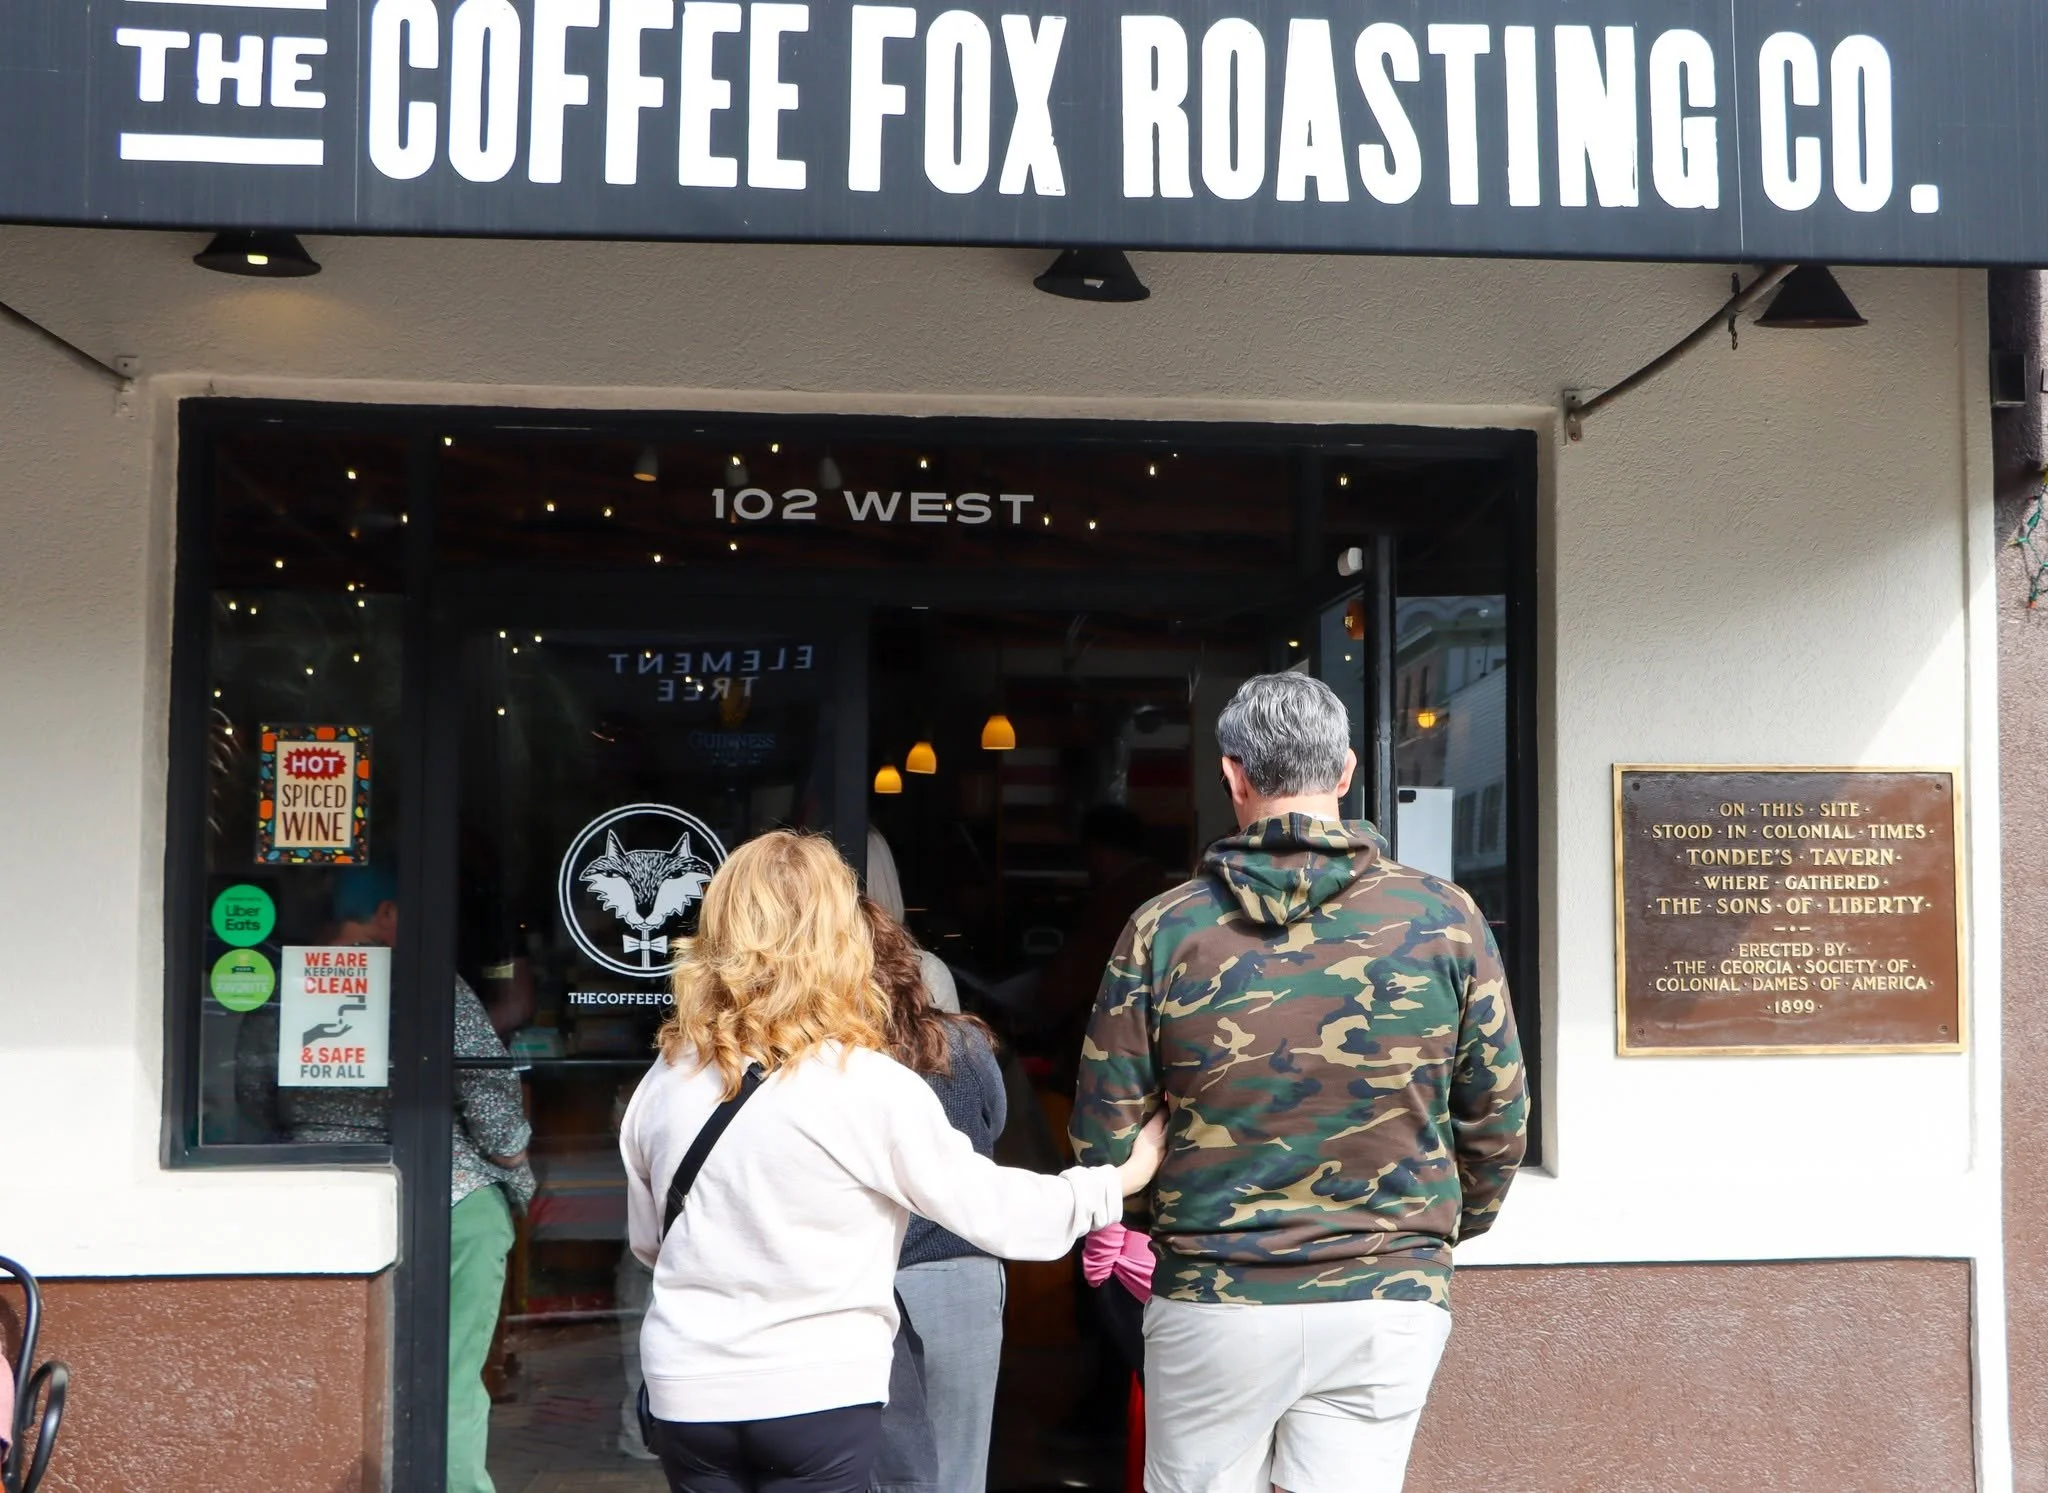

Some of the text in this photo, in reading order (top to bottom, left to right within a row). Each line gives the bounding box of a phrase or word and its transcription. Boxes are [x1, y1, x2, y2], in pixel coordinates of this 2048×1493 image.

[117, 28, 328, 108] THE
[369, 0, 1940, 213] COFFEE FOX ROASTING CO.
[711, 488, 1034, 524] 102 WEST
[291, 756, 341, 774] HOT
[281, 784, 347, 808] SPICED
[1719, 802, 1861, 817] ON THIS SITE
[282, 811, 345, 842] WINE
[1652, 824, 1926, 840] STOOD IN COLONIAL TIMES
[1809, 848, 1894, 866] TAVERN
[1703, 875, 1880, 890] WHERE GATHERED
[225, 904, 261, 917] Uber
[1655, 896, 1925, 915] THE SONS OF LIBERTY
[225, 918, 261, 931] Eats
[1738, 943, 1846, 957] ERECTED BY
[305, 953, 368, 968] WE ARE
[1672, 960, 1909, 975] THE GEORGIA SOCIETY OF
[304, 967, 368, 978] KEEPING IT
[305, 978, 368, 995] CLEAN
[1655, 976, 1928, 992] COLONIAL DAMES OF AMERICA
[568, 993, 674, 1005] THECOFFEEFO
[1774, 1000, 1815, 1014] 1899
[301, 1047, 366, 1064] & SAFE
[300, 1064, 366, 1079] FOR ALL
